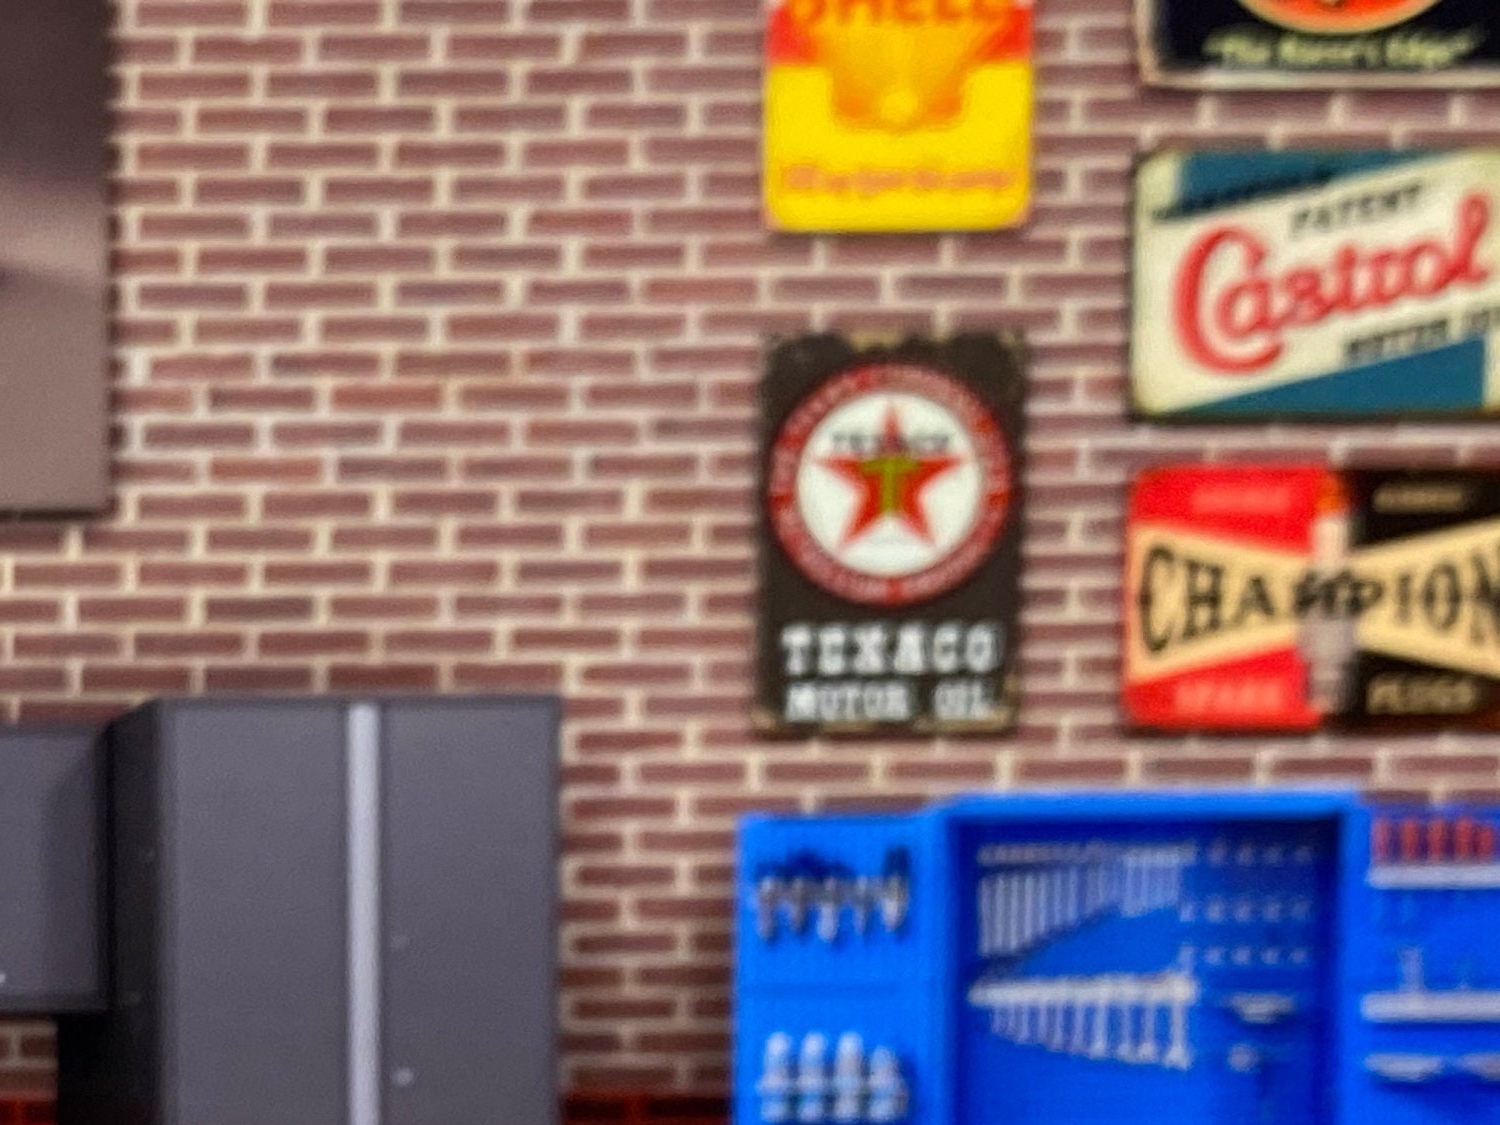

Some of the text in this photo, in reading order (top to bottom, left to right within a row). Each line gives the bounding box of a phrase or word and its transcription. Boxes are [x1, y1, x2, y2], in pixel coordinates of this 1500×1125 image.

[1171, 188, 1490, 376] Castrol
[1138, 546, 1500, 655] CHAMPION
[781, 622, 998, 676] TEXACO
[786, 680, 993, 723] MOTOR OIL
